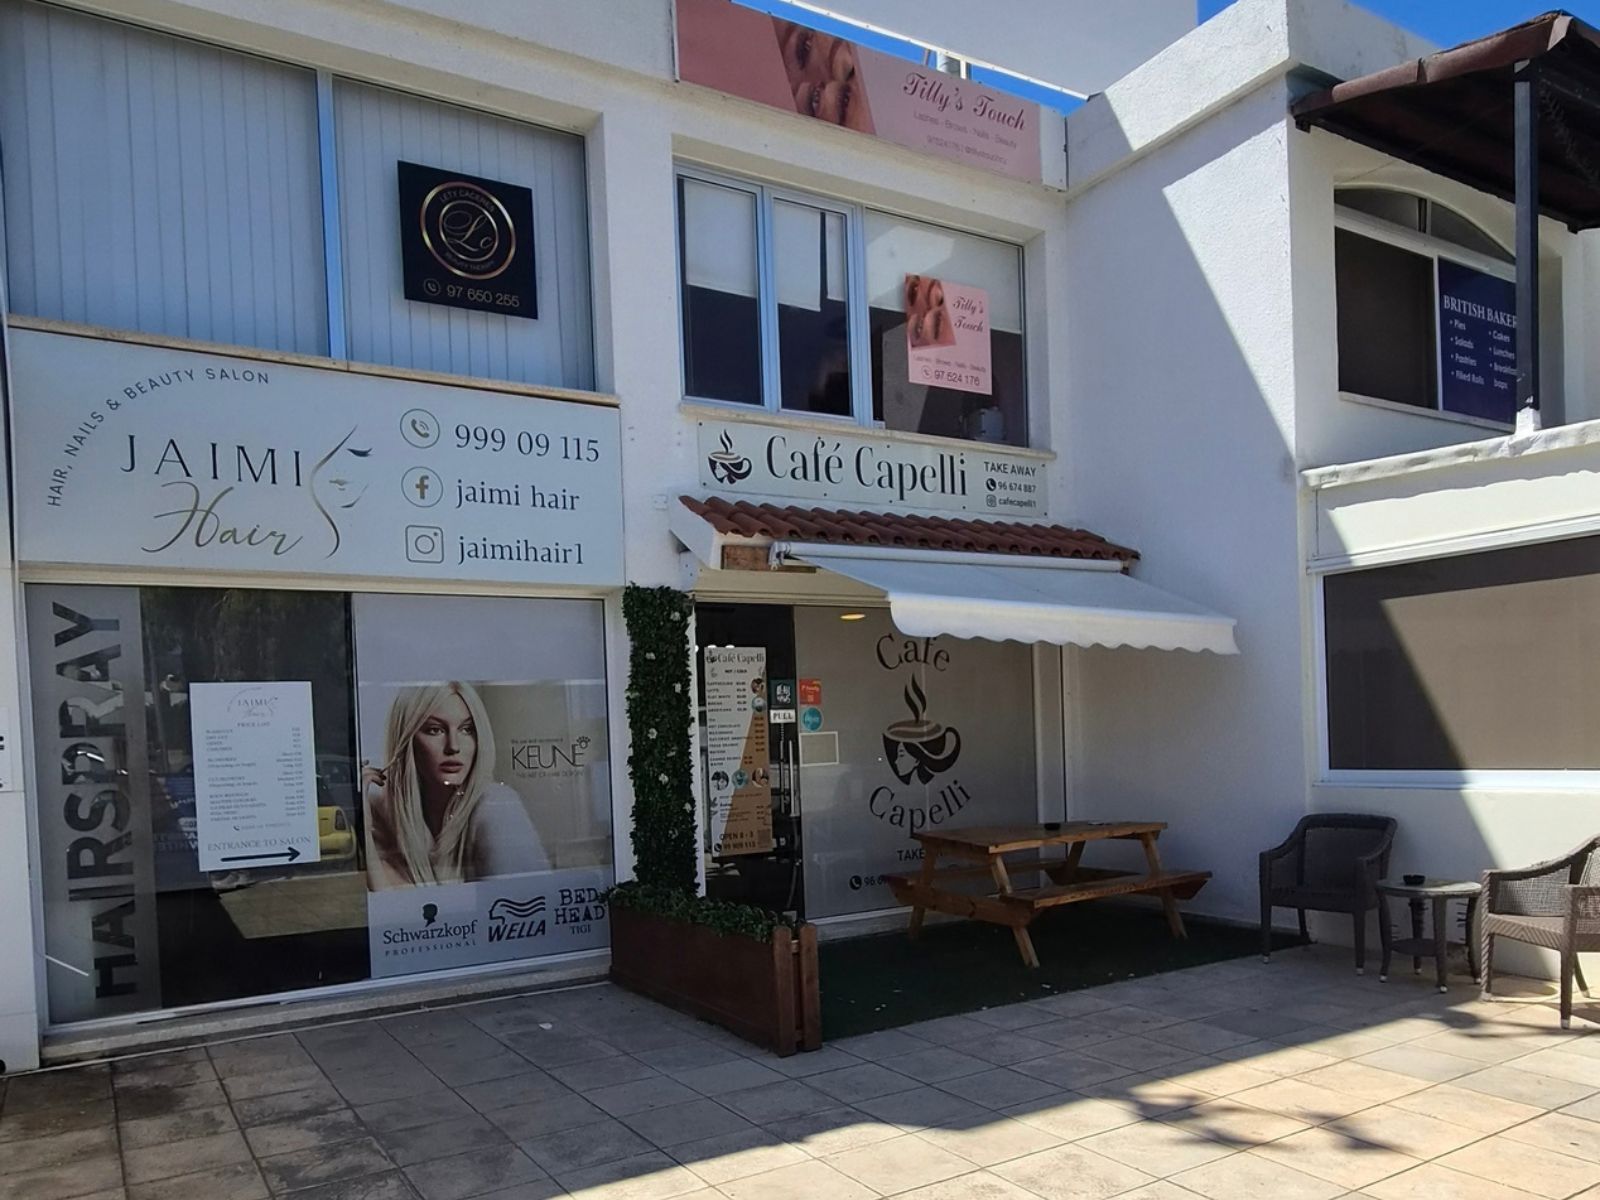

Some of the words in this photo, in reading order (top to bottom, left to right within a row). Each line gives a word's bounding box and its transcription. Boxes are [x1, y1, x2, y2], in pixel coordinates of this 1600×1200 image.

[903, 72, 964, 112] Tilly's
[973, 95, 1025, 131] Touch
[447, 285, 463, 297] 97
[953, 295, 984, 315] Tilly's
[1443, 294, 1486, 320] BRITISH
[954, 316, 984, 333] Touch
[66, 411, 105, 458] NAILS
[106, 397, 122, 411] &
[123, 369, 195, 400] BEAUTY
[206, 367, 271, 385] SALON
[454, 425, 506, 452] 999
[517, 433, 551, 457] 09
[560, 436, 600, 463] 115
[121, 434, 302, 487] JAIMI
[766, 434, 843, 485] Café
[855, 445, 968, 502] Capelli
[984, 461, 1009, 474] TAKE
[1010, 464, 1037, 477] AWAY
[455, 478, 521, 509] jaimi
[530, 484, 580, 511] hair
[141, 481, 304, 556] Hair
[457, 536, 584, 565] jaimihair1
[773, 712, 793, 721] PULL
[511, 743, 585, 771] KEUNE
[53, 601, 138, 999] HAIRSPRAY
[869, 779, 972, 839] Capelli
[208, 839, 262, 852] ENTRANCE
[263, 838, 277, 848] TO
[279, 835, 312, 847] SALON
[896, 848, 926, 862] TAKE
[558, 888, 598, 906] BED
[554, 906, 605, 925] HEAD
[383, 919, 478, 945] Schwarzkopf
[488, 919, 546, 943] WELLA
[569, 924, 591, 935] TIGI
[385, 939, 477, 957] PROFESSIONAL
